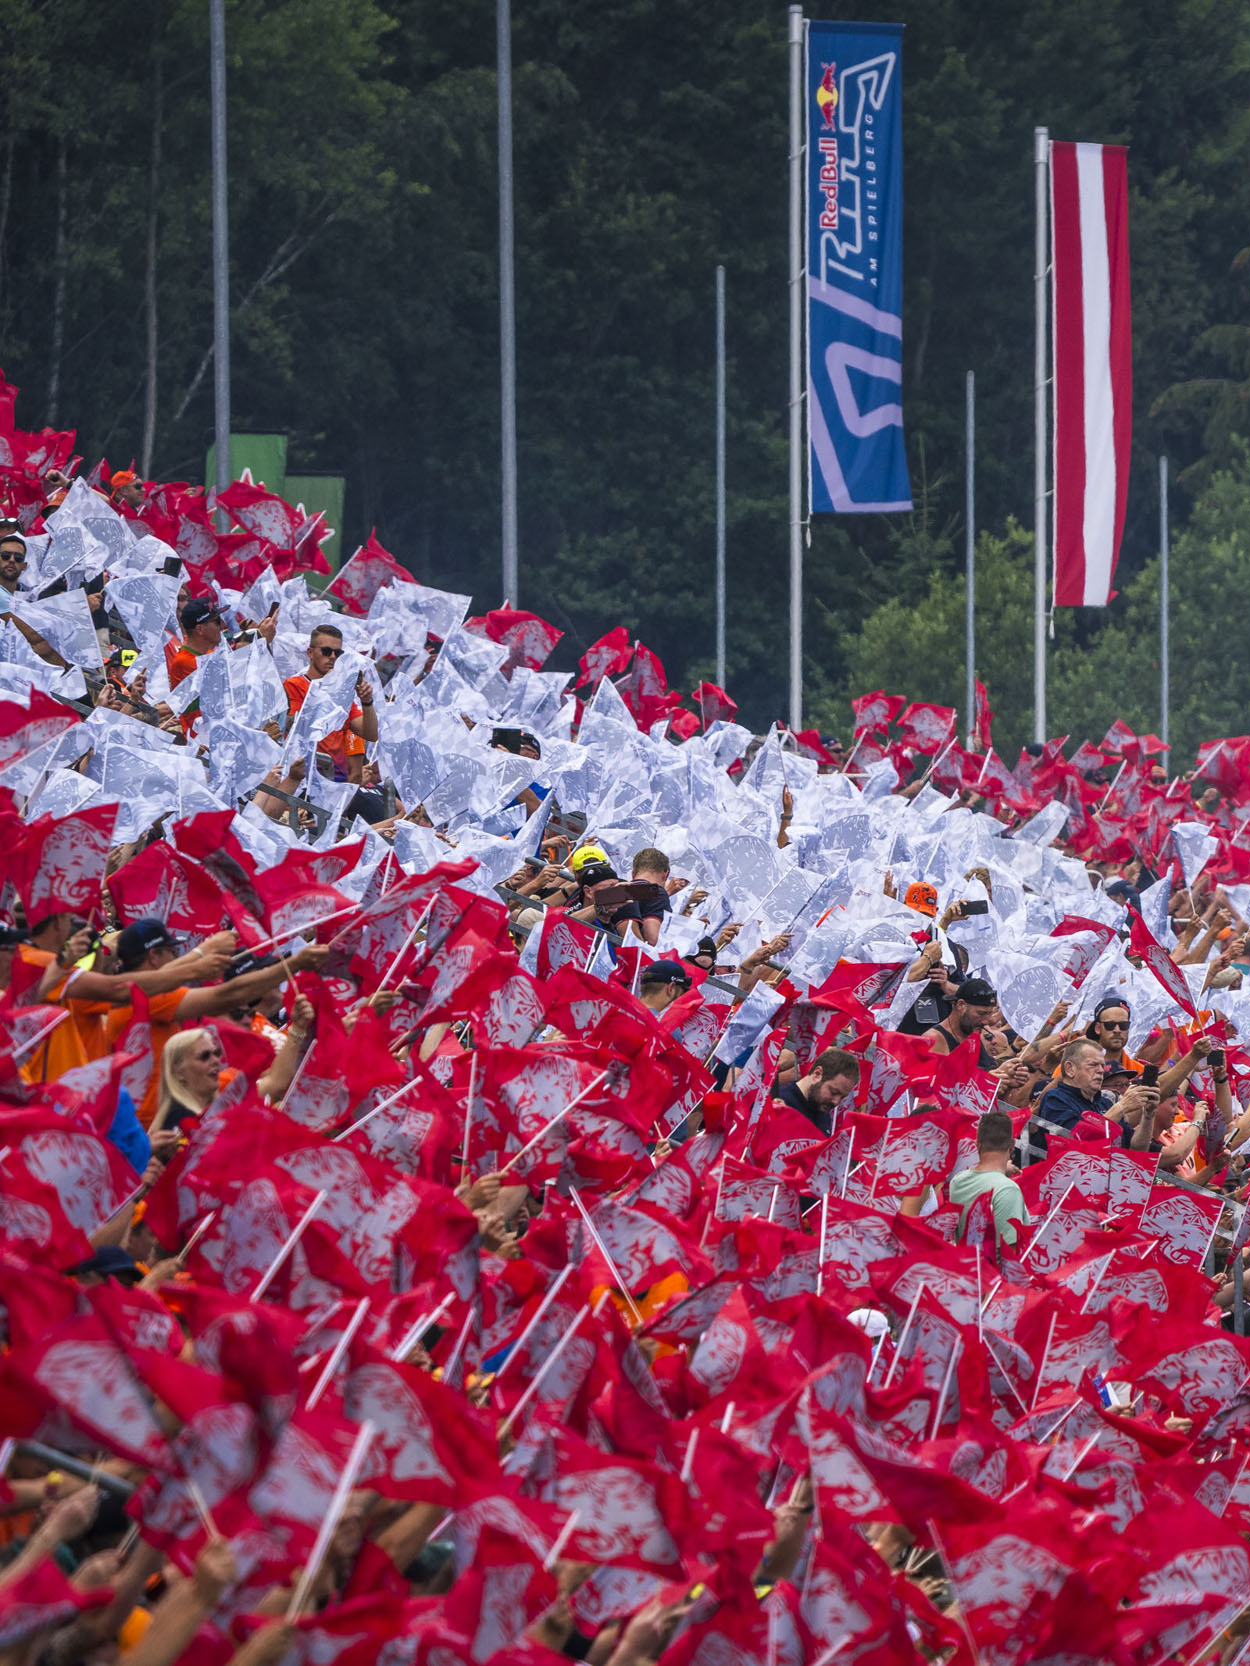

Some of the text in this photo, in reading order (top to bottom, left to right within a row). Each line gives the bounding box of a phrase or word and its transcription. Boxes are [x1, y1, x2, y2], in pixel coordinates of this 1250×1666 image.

[818, 137, 839, 229] Red Bull
[864, 113, 878, 287] AM SPIELBERG
